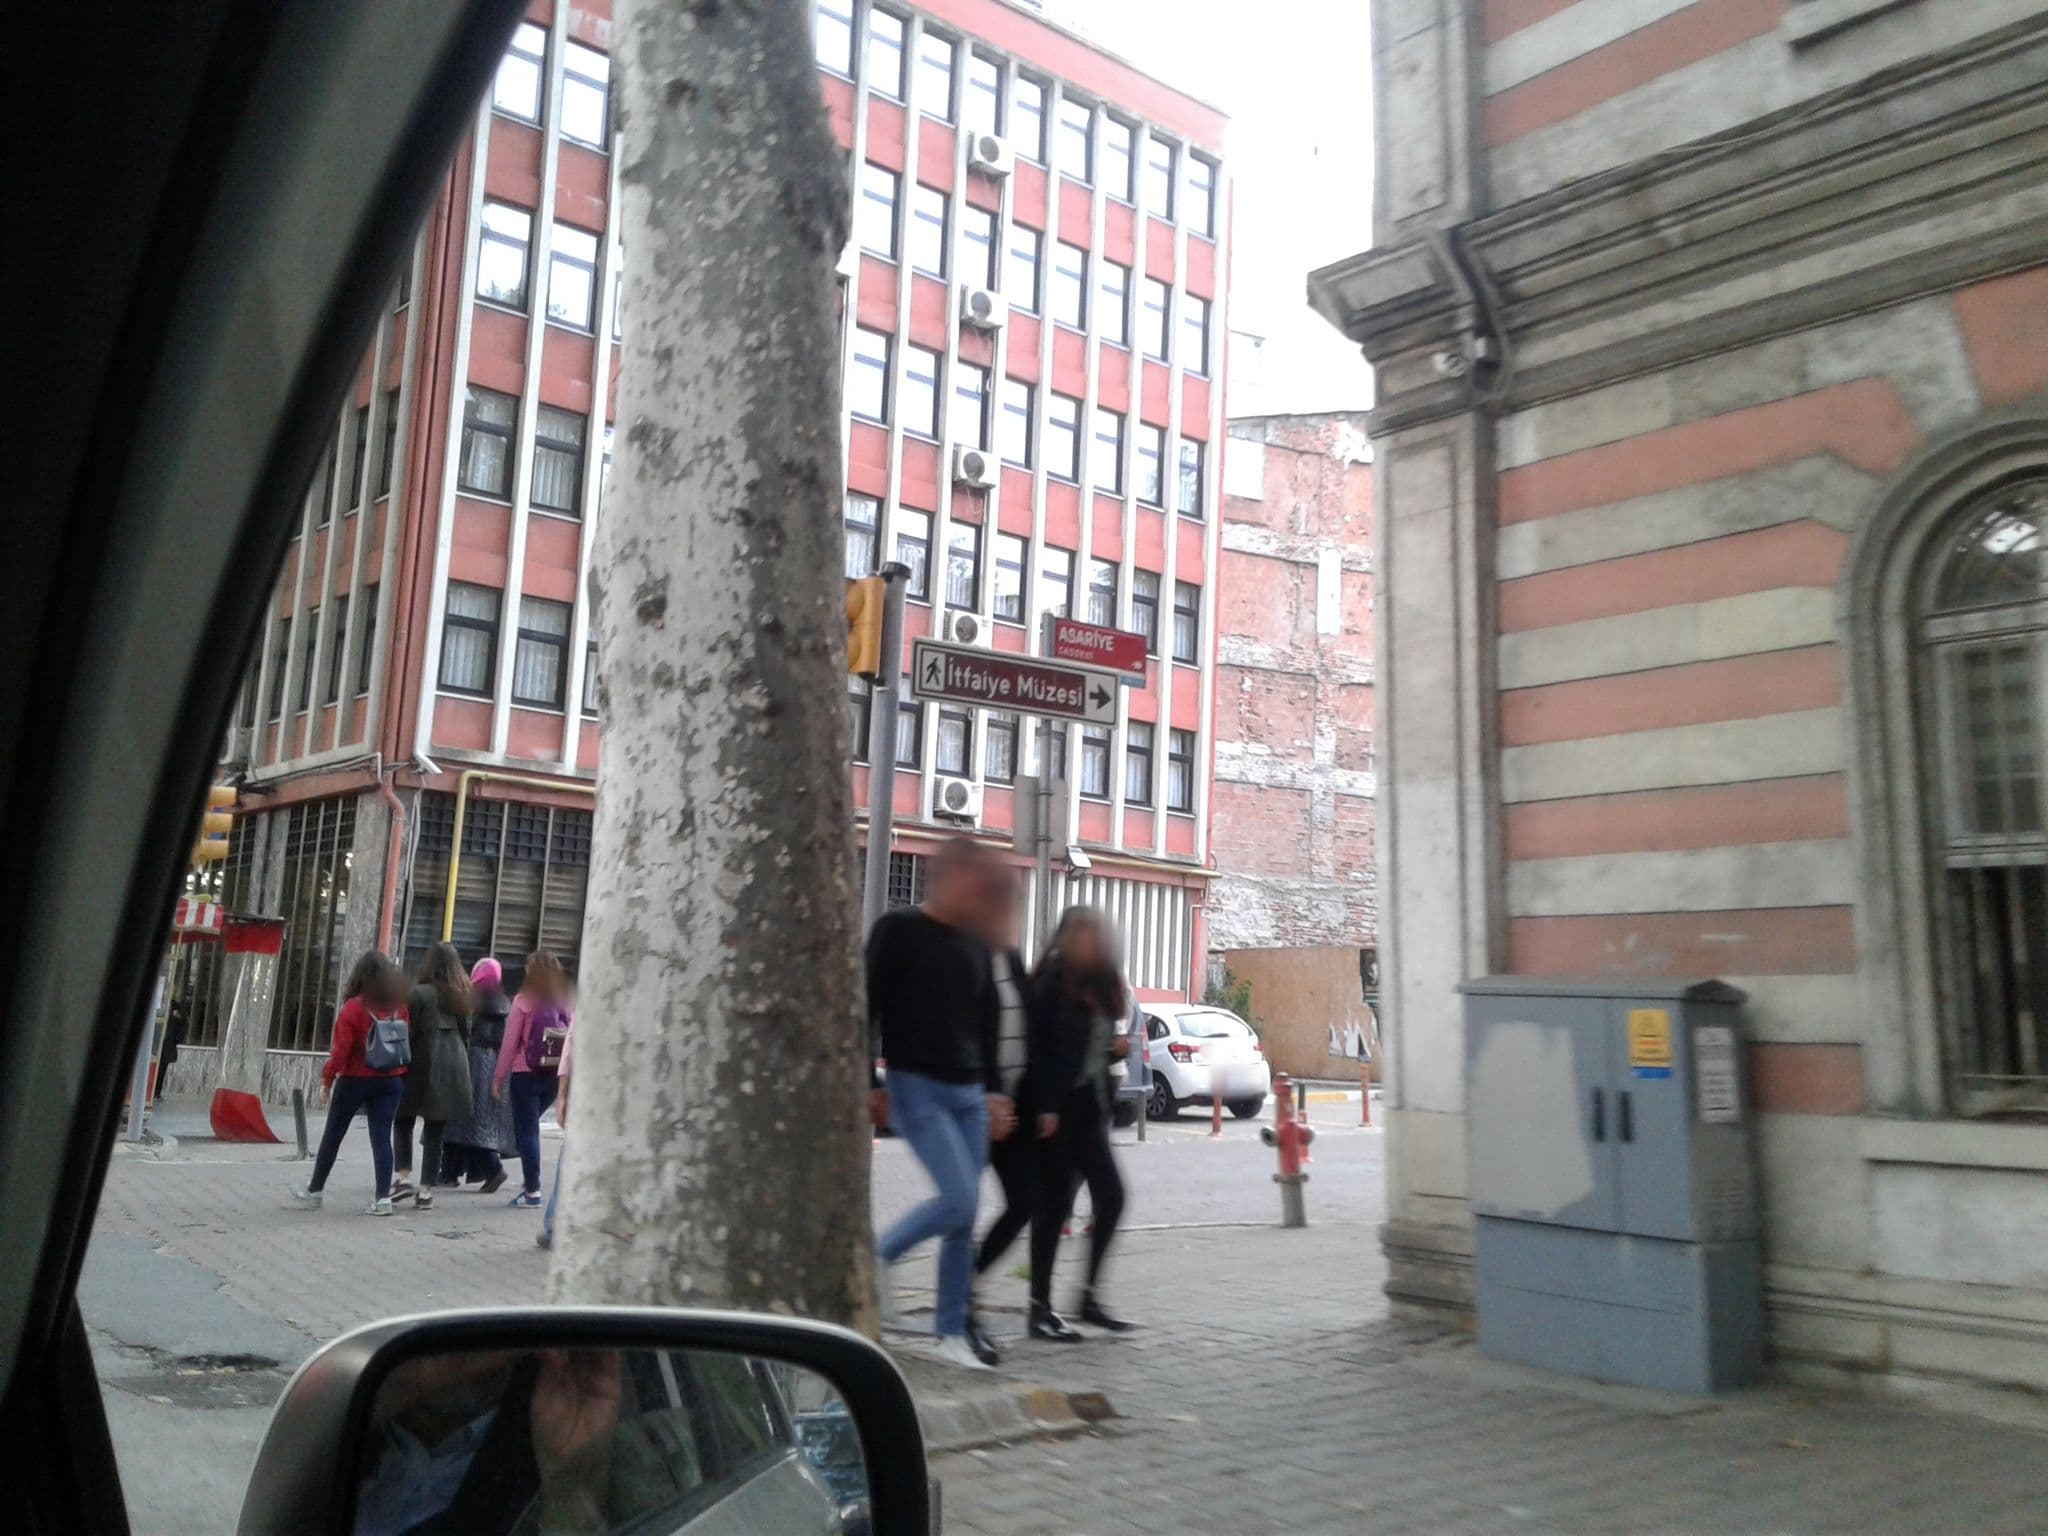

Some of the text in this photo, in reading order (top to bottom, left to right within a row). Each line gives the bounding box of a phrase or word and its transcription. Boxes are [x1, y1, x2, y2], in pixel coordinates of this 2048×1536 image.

[1058, 626, 1115, 652] ASARİYE
[948, 657, 1082, 706] İtfaiye Müzesi
